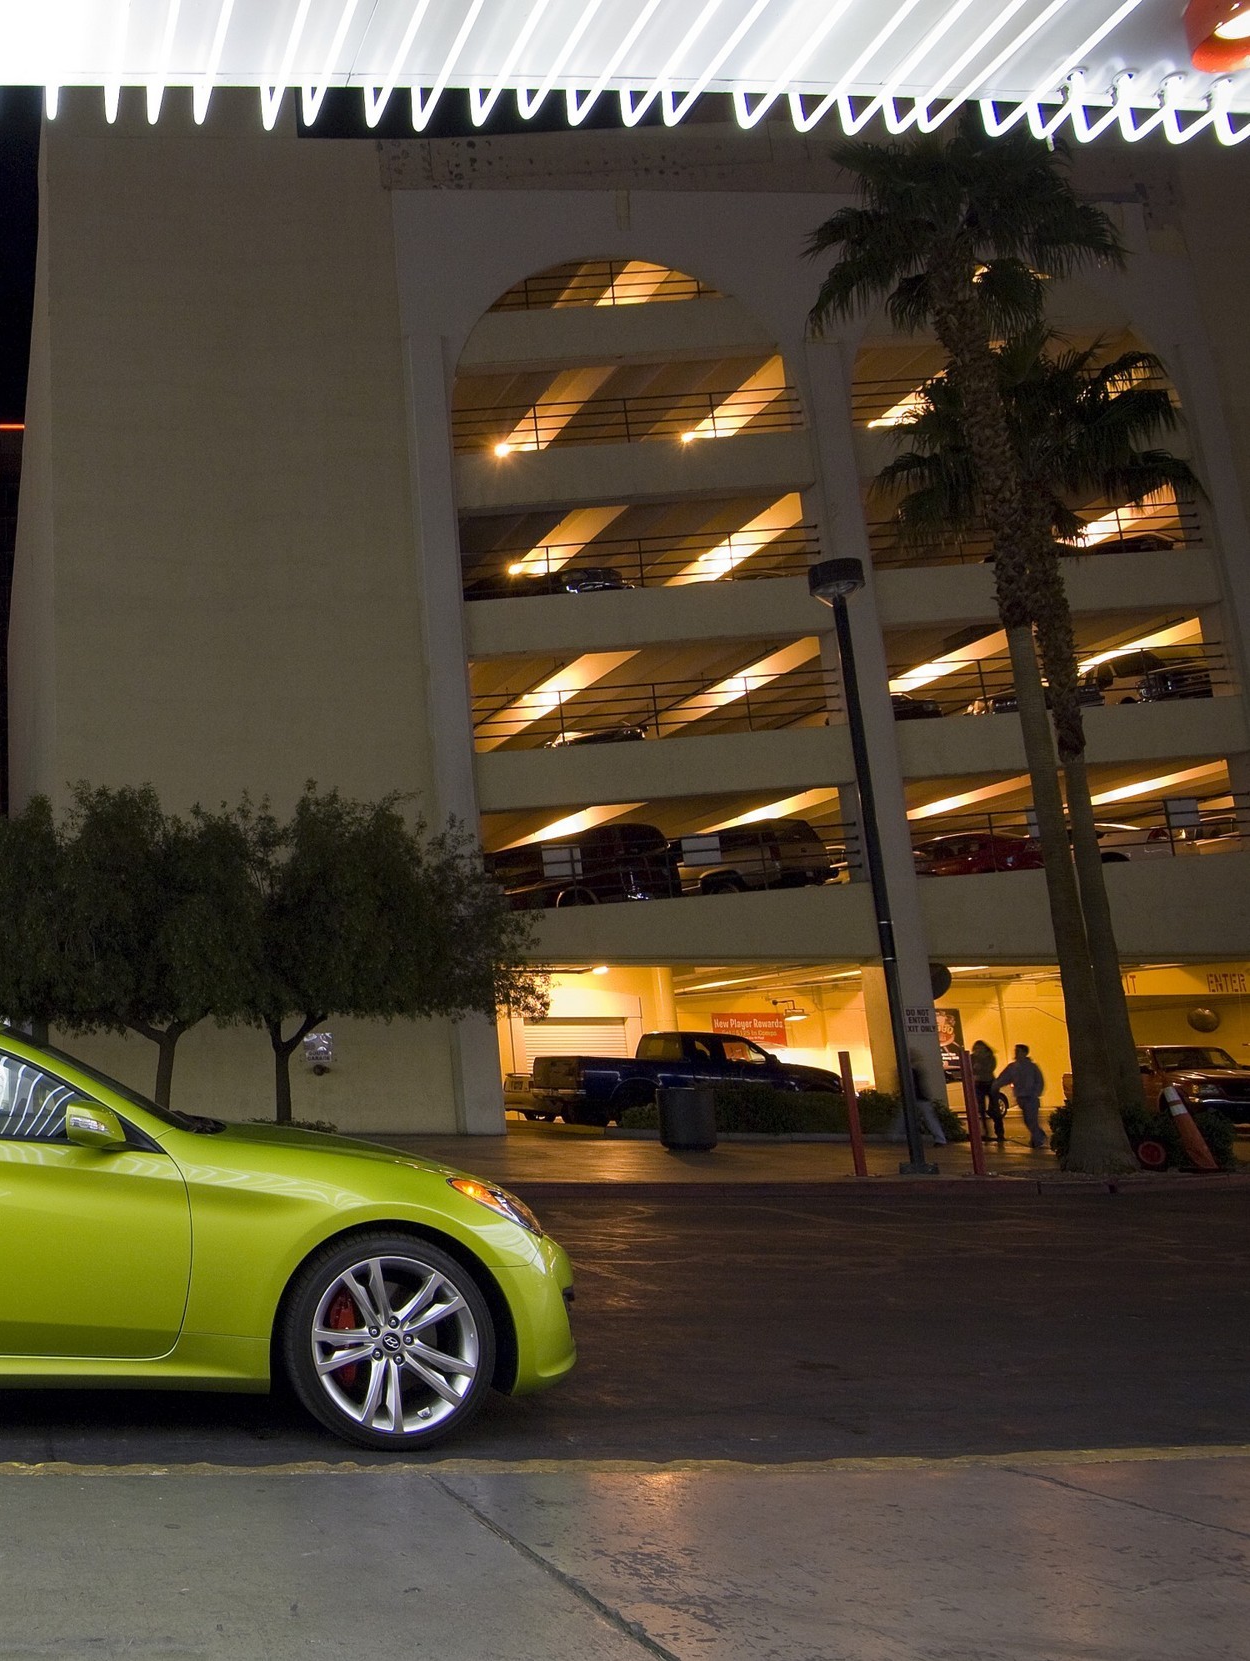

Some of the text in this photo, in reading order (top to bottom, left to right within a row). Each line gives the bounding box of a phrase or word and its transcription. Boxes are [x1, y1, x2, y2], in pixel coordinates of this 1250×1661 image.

[1206, 974, 1247, 993] ENTER
[714, 1018, 783, 1030] New Player Rewards
